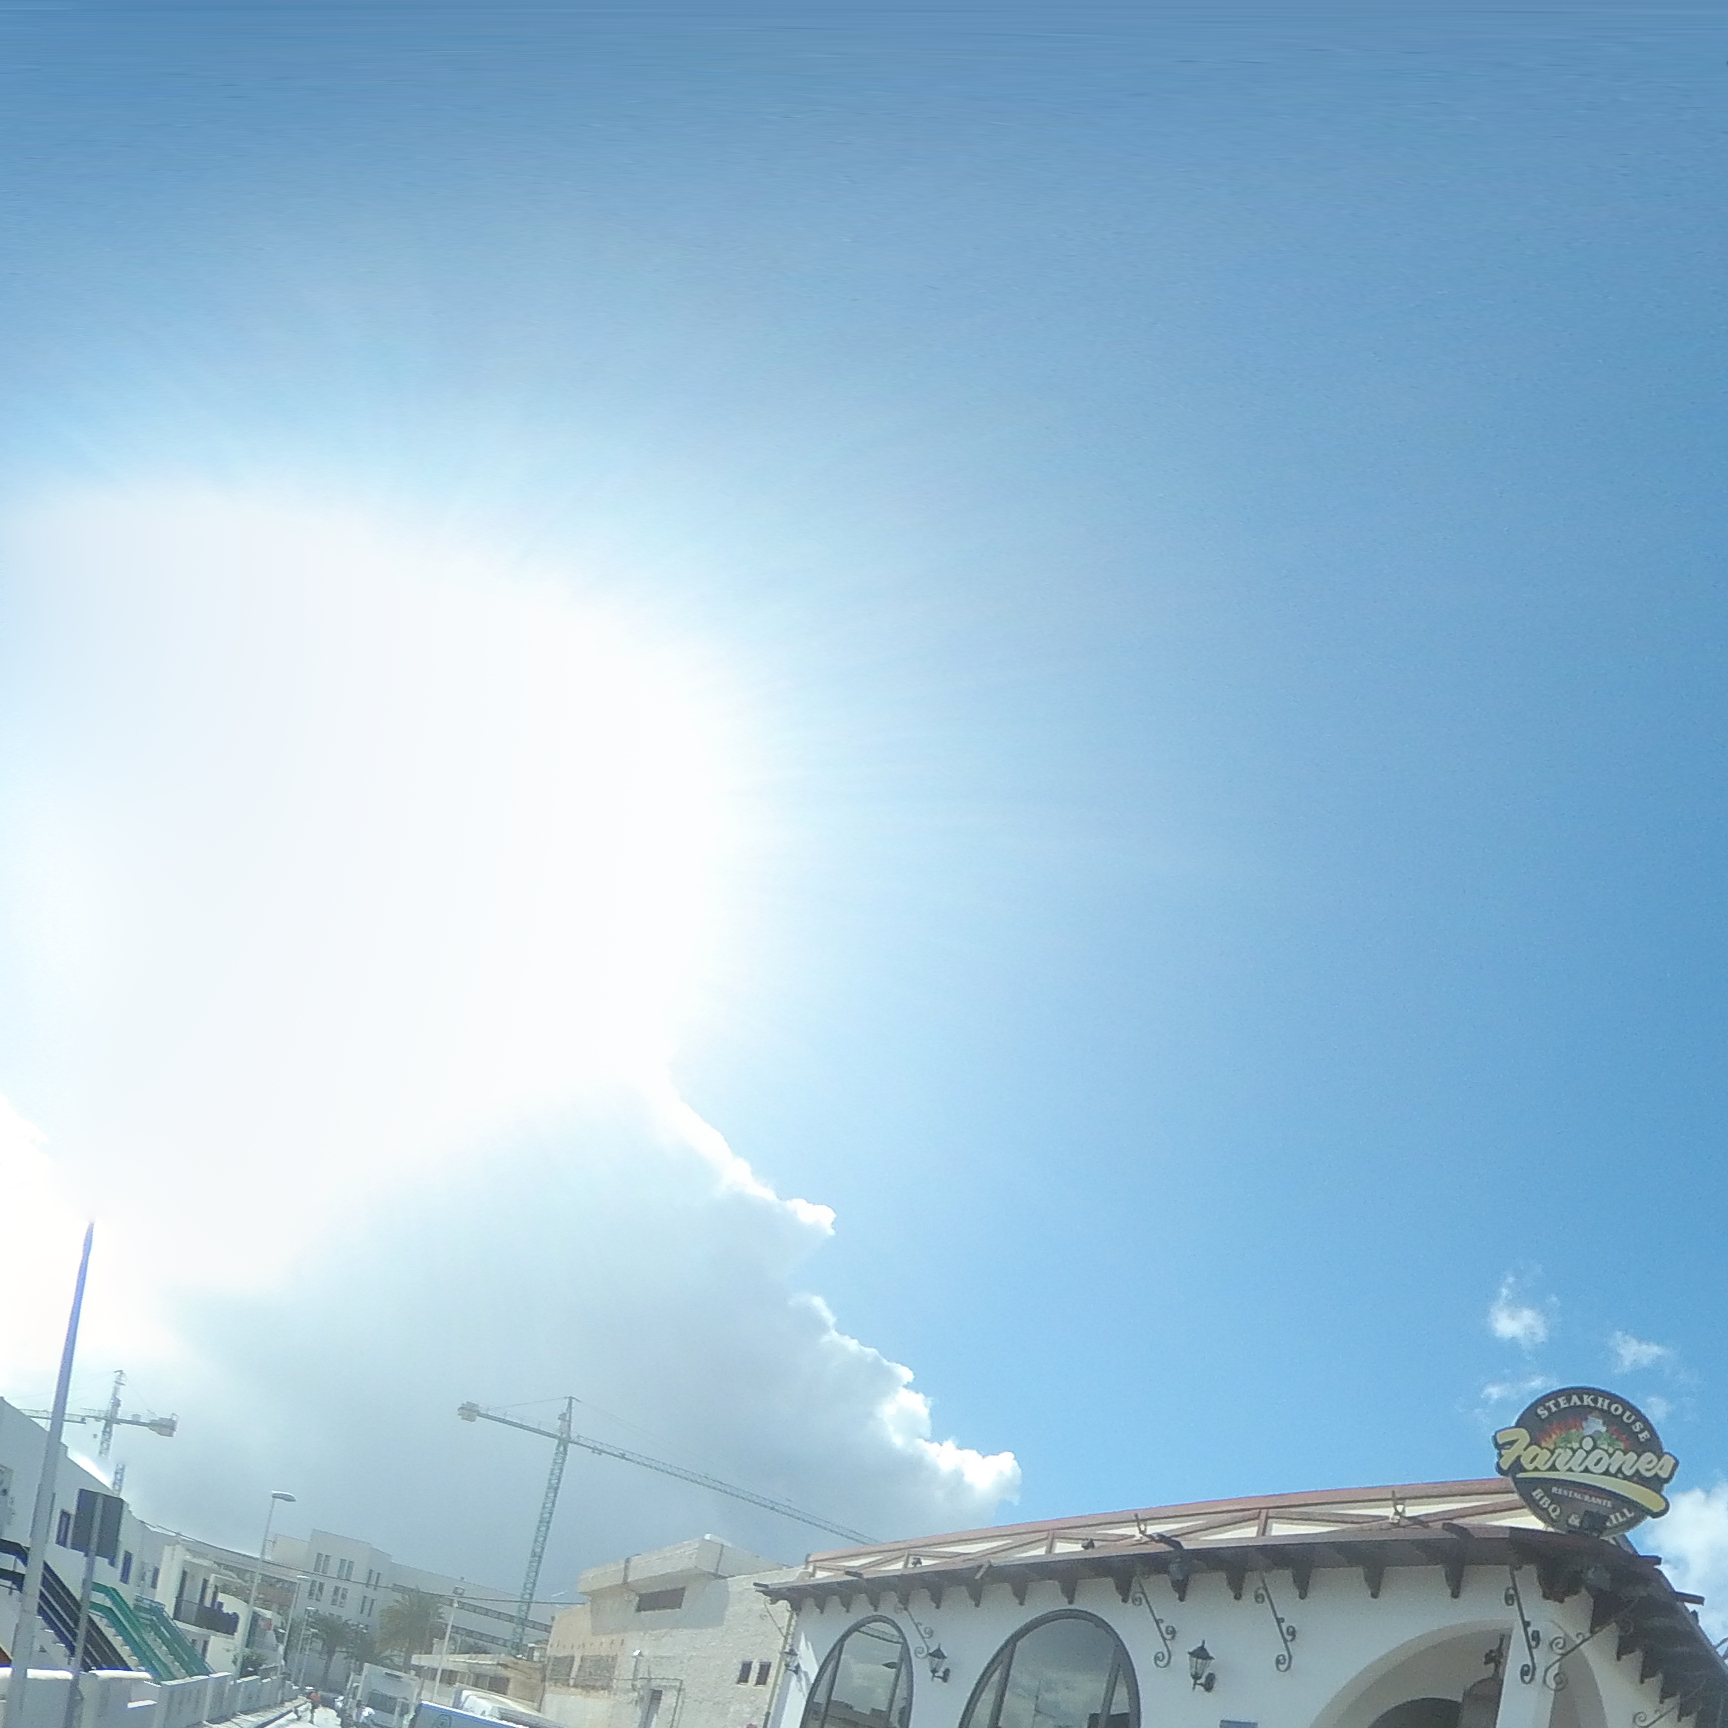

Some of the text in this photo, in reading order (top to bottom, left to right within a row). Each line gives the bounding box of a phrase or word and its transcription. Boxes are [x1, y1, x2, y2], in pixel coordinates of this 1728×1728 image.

[1536, 1394, 1652, 1443] STEAKHOUSE
[1495, 1427, 1676, 1479] Fariones
[1531, 1488, 1561, 1520] BBQ
[1567, 1513, 1581, 1527] &
[1551, 1486, 1613, 1508] RESTAURANTE
